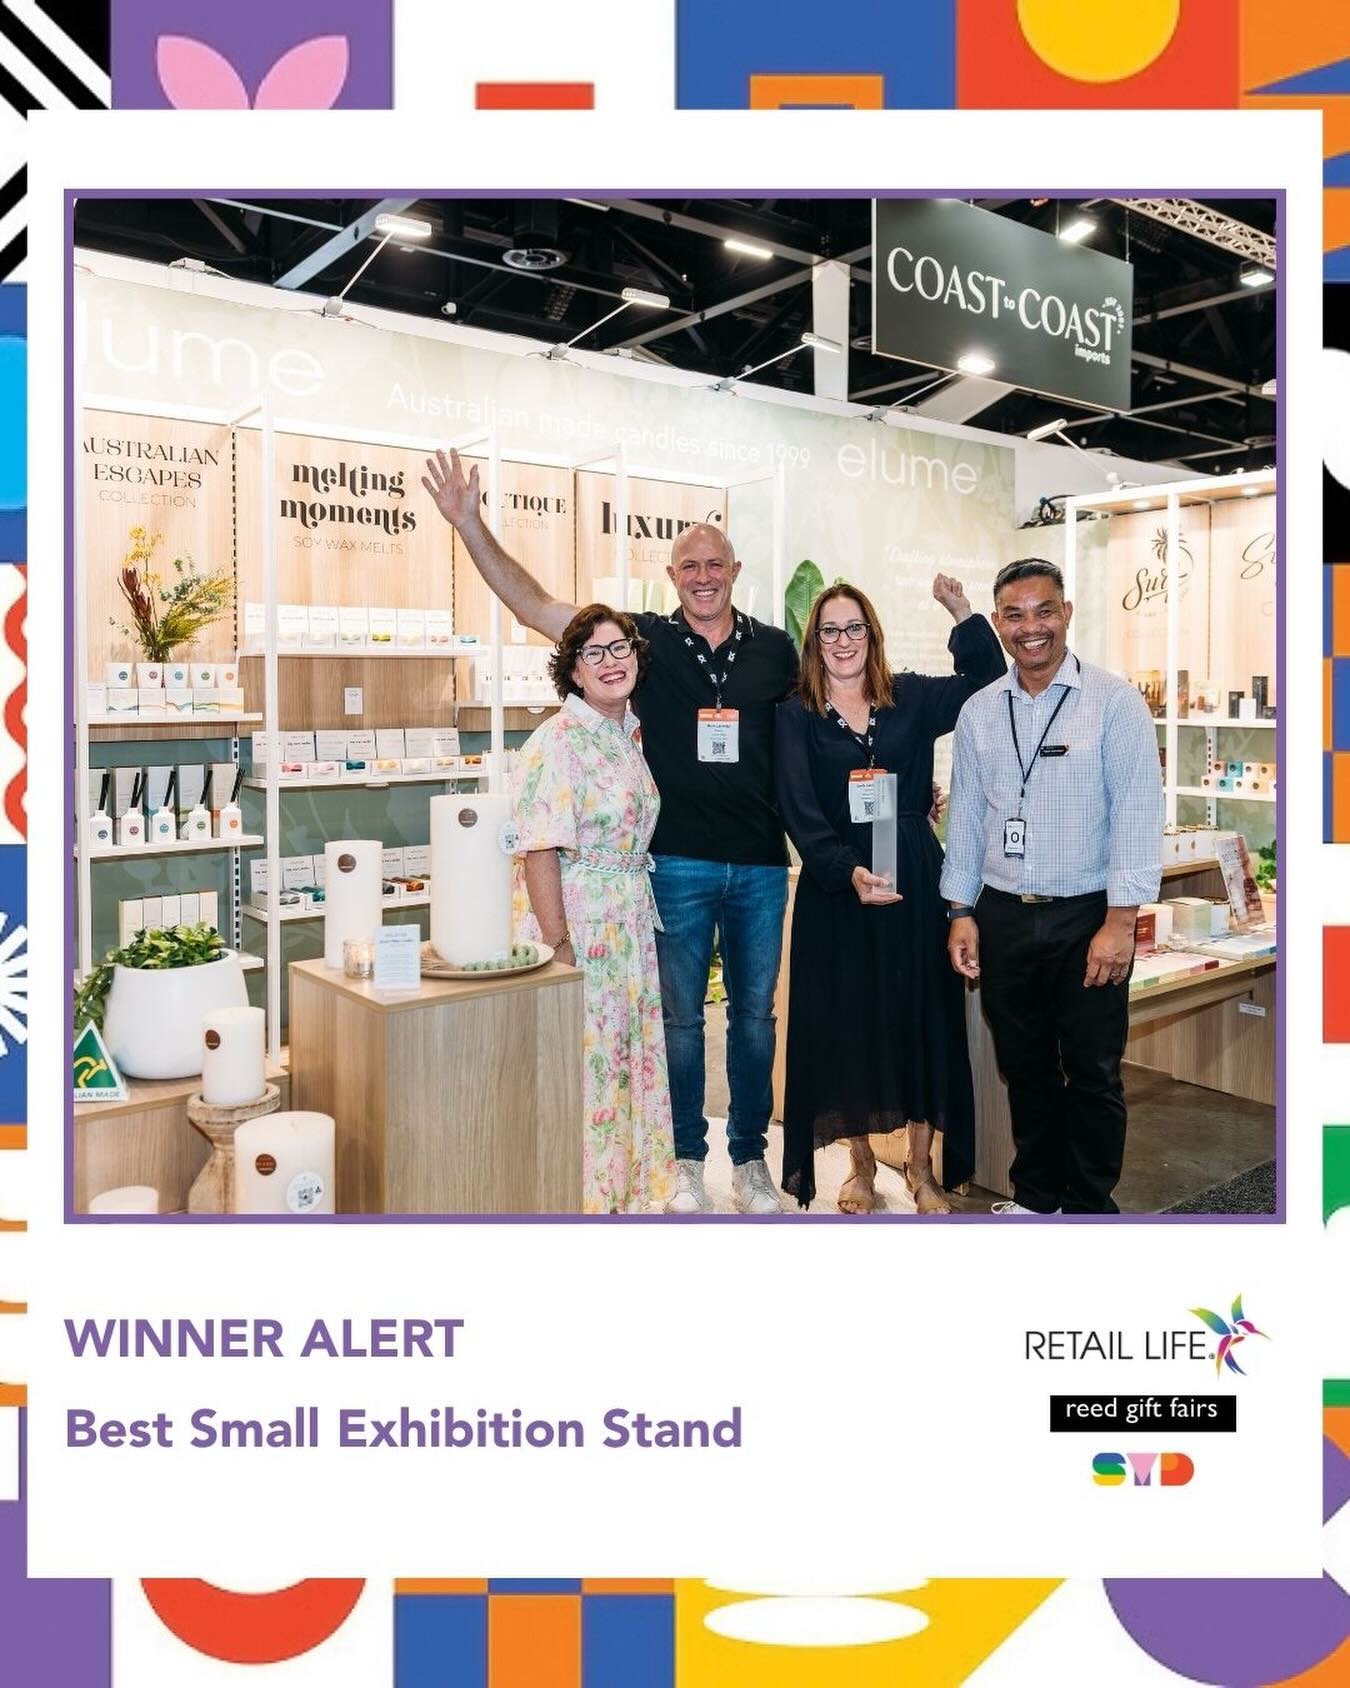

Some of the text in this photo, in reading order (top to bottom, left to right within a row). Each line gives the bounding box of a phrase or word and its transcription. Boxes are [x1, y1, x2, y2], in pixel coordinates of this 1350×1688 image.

[887, 247, 1005, 318] COAST
[1018, 288, 1117, 351] COAST
[1074, 343, 1111, 366] imports
[386, 383, 528, 429] Australian
[538, 410, 607, 440] made
[615, 424, 701, 456] candles
[708, 440, 760, 463] since
[94, 463, 202, 489] ESCAPES
[292, 462, 406, 499] melting
[837, 437, 977, 494] elume
[99, 489, 196, 508] COLLECTION
[279, 499, 417, 536] moments
[325, 538, 357, 551] WAX
[360, 541, 404, 555] MELTS
